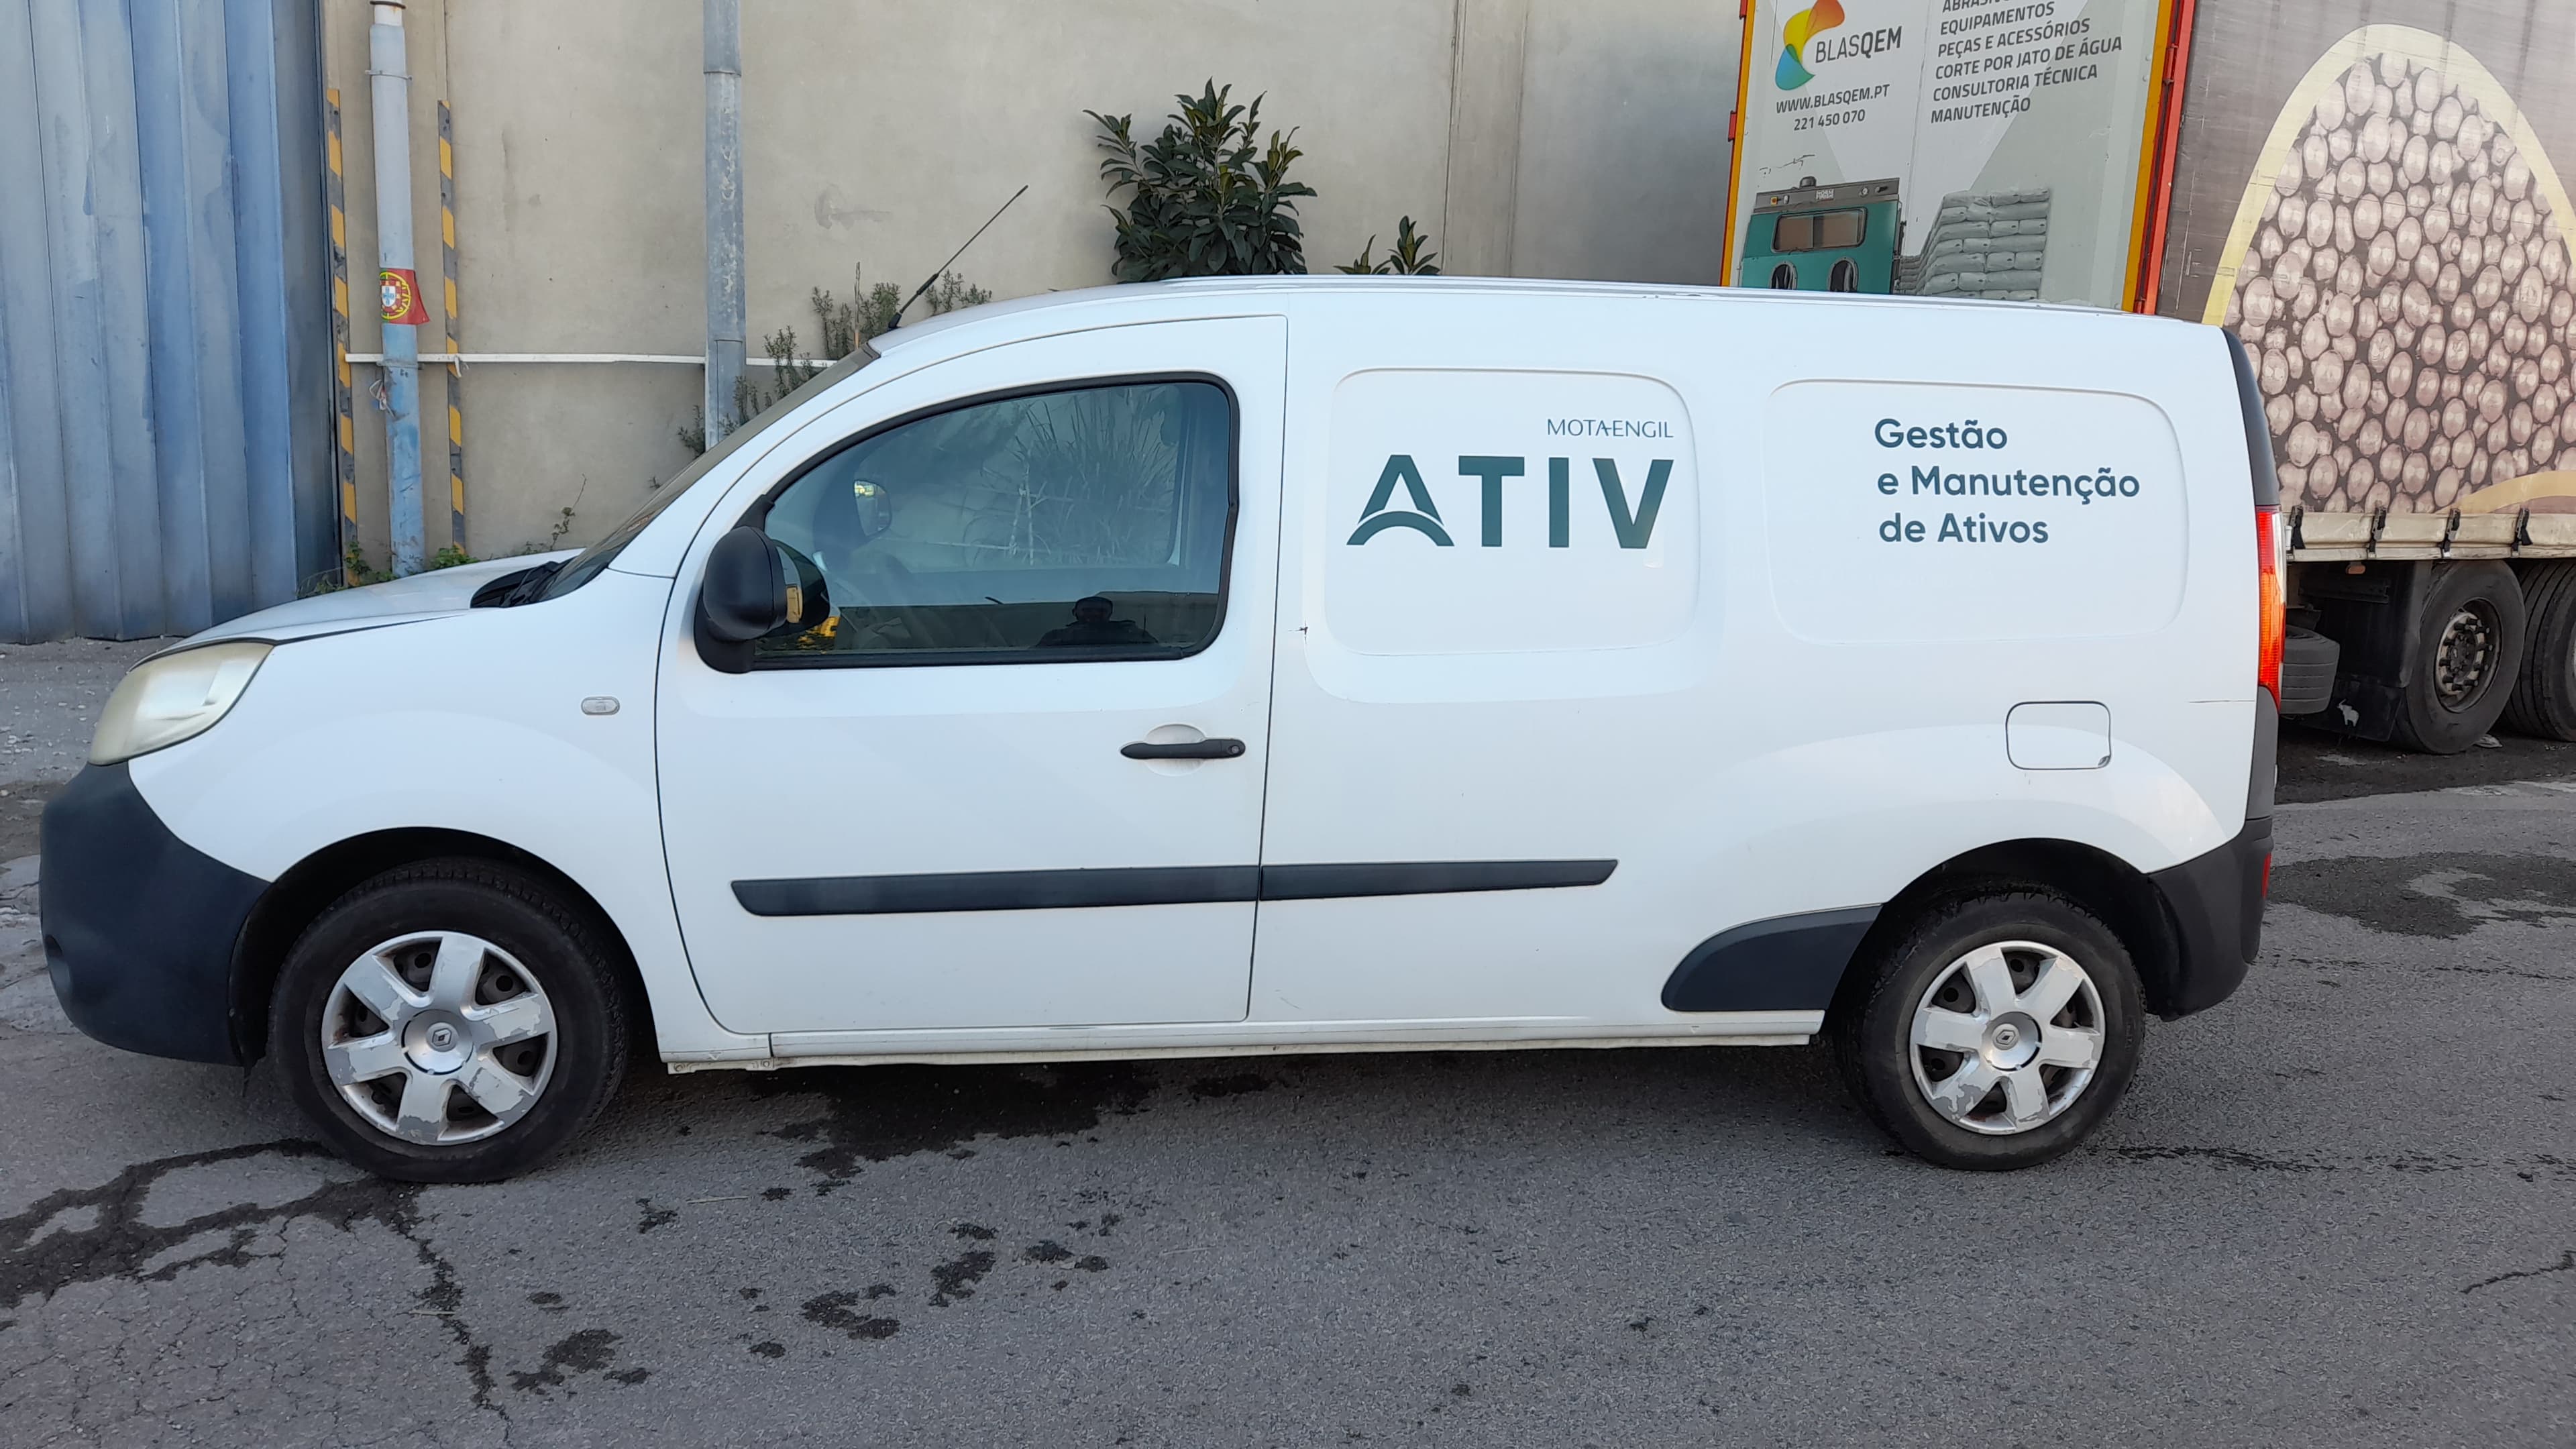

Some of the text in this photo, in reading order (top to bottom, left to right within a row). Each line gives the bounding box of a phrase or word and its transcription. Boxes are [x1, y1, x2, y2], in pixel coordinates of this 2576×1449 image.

[1940, 1, 2055, 35] EQUIPAMENTOS
[1815, 25, 1902, 63] BLASQEM
[1938, 18, 2091, 58] PEÇAS E ACESSÓRIOS
[1935, 36, 2123, 79] CORTE POR JATO DE ÁGUA
[1776, 84, 1890, 113] WWW.BLASQEM.PT
[1933, 64, 2098, 101] CONSULTORIA TÉCNICA
[1794, 109, 1866, 131] 221 450 070
[1931, 95, 2031, 123] MANUTENÇÃO
[1874, 418, 2008, 449] Gestão
[1346, 454, 1674, 549] ATIV
[1878, 466, 2140, 504] e Manutenção
[1879, 513, 2049, 543] de Ativos
